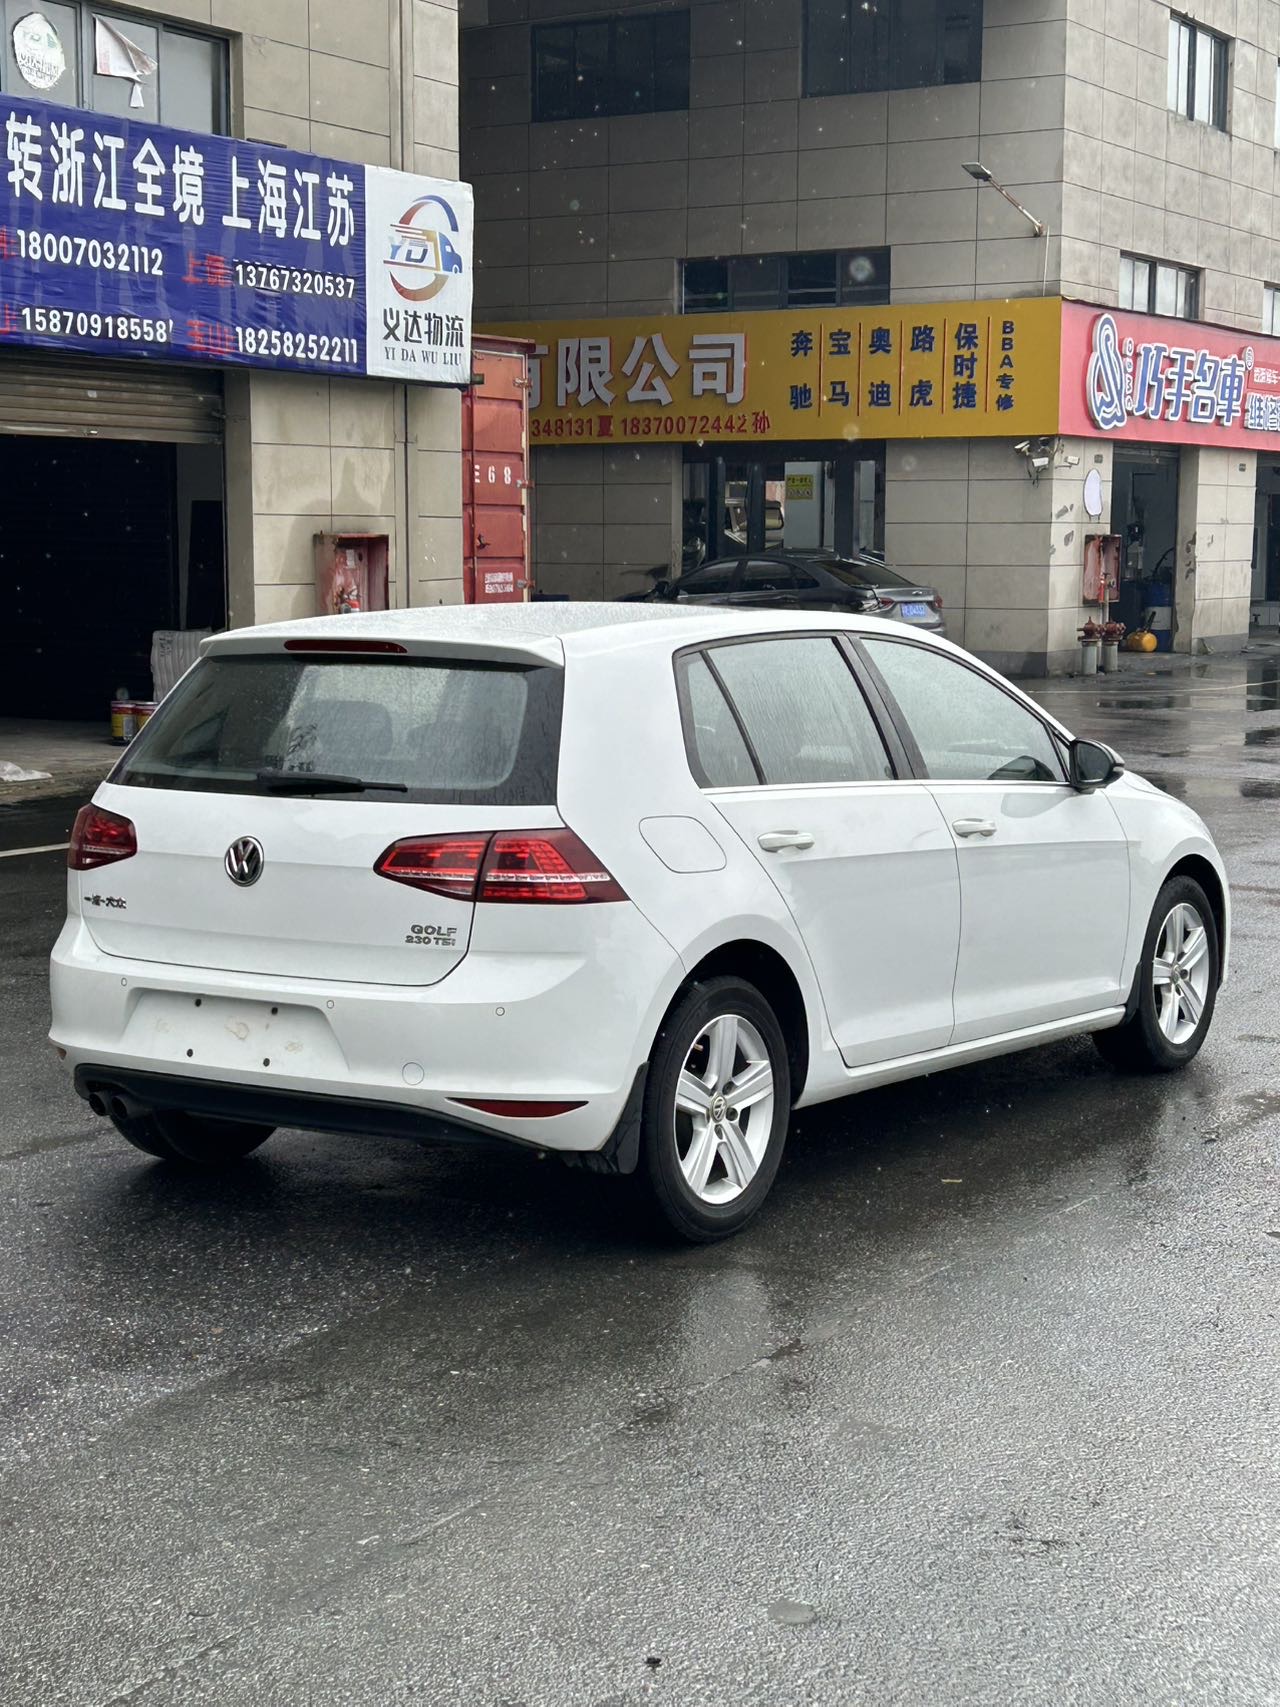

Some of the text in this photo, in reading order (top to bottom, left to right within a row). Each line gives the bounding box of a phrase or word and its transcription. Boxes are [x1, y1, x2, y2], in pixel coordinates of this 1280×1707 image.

[6, 111, 355, 247] 转浙江全境 上海江苏
[17, 229, 163, 276] 18007032112
[235, 264, 355, 298] 13767320537
[236, 326, 357, 363] 18258252211
[383, 306, 464, 347] 义达物流
[385, 346, 462, 366] YI DA WU LIU
[790, 329, 813, 410] 奔驰
[828, 328, 851, 407] 宝马
[868, 326, 892, 407] 奥迪
[909, 324, 935, 407] 路虎
[952, 322, 978, 410] 保时捷
[410, 924, 457, 937] GOLF
